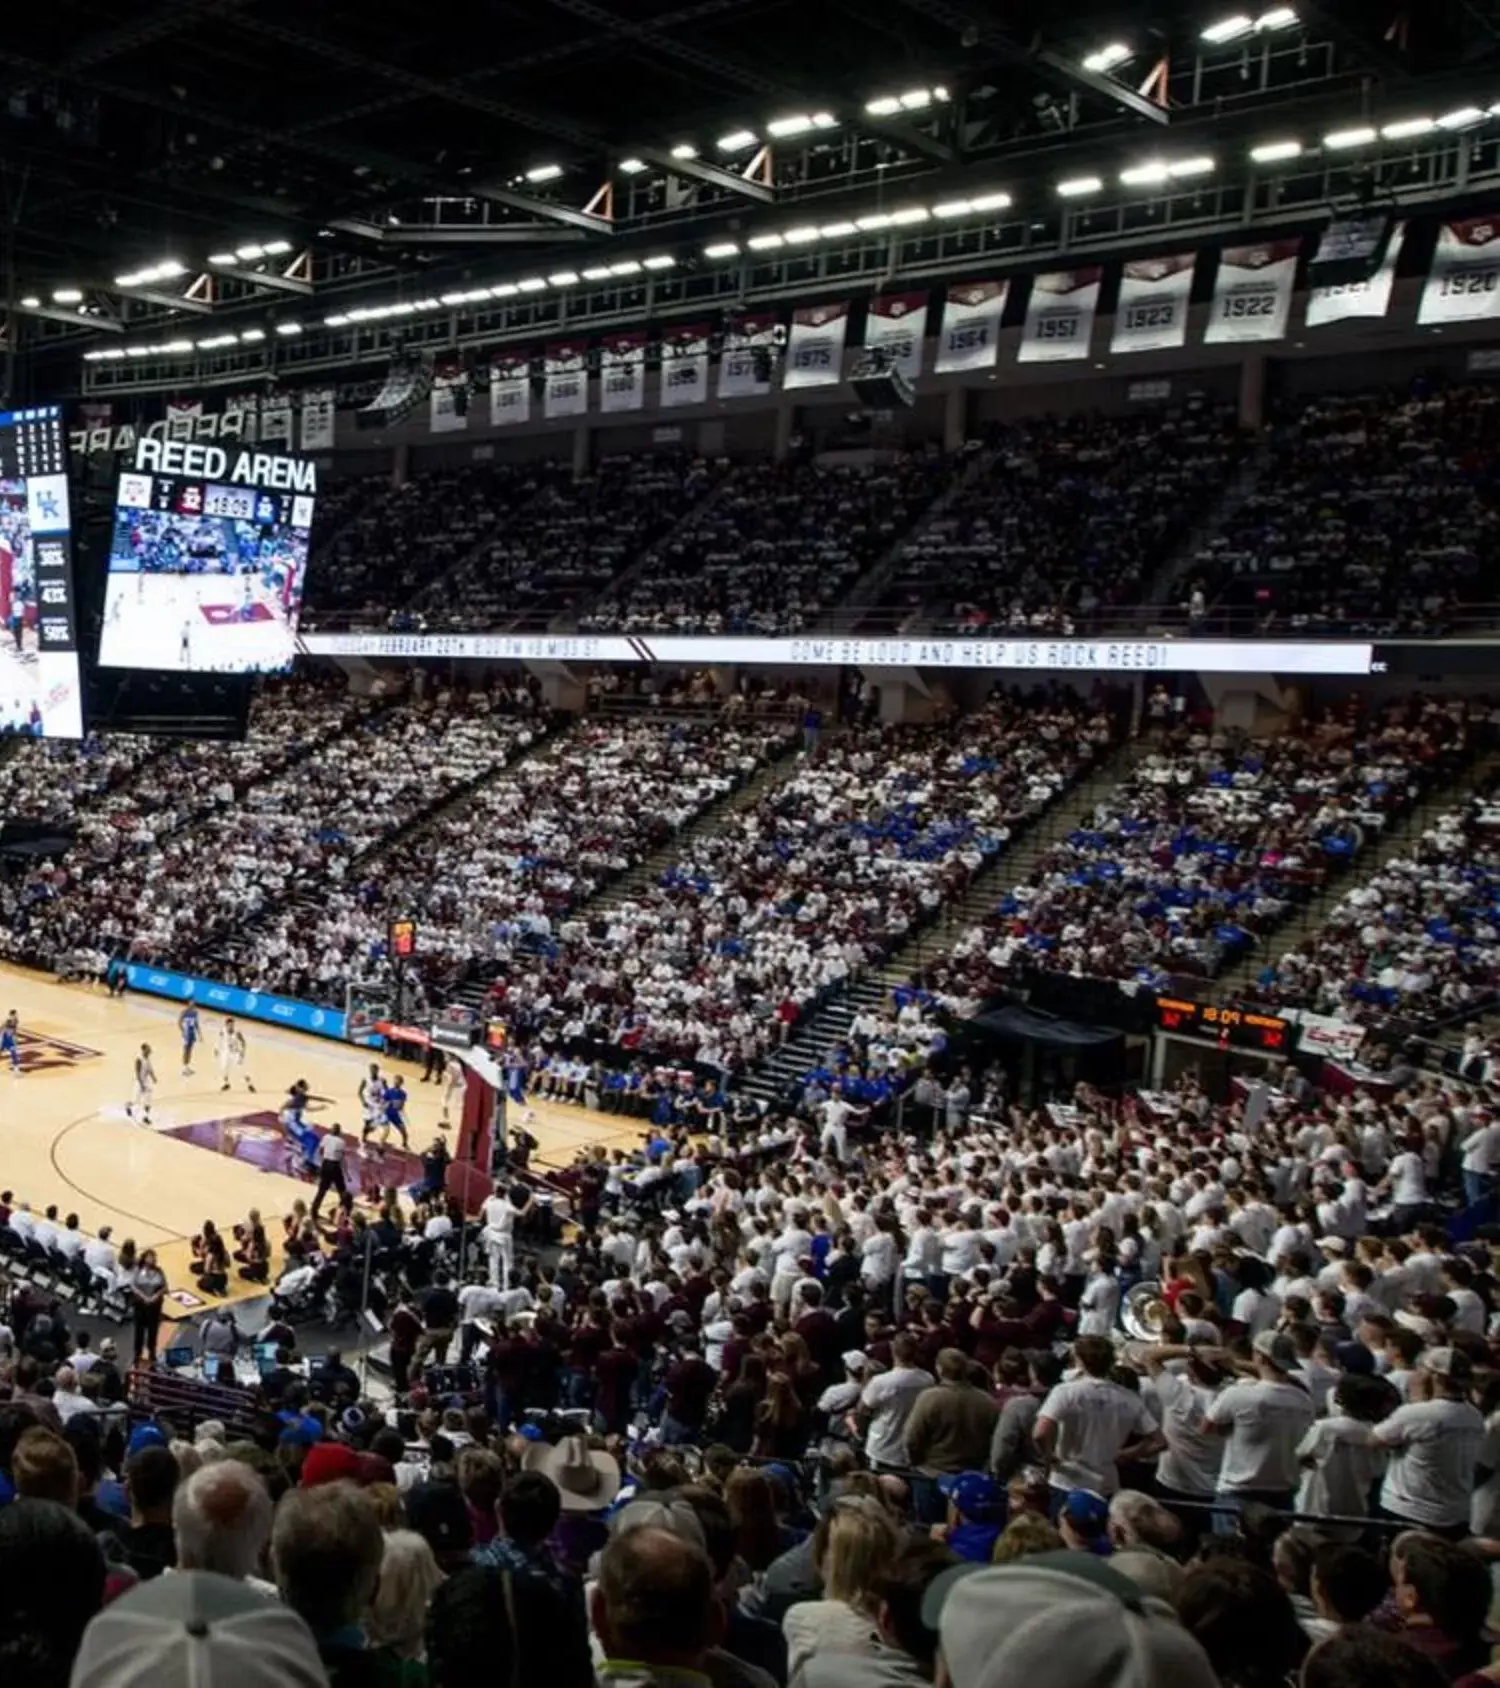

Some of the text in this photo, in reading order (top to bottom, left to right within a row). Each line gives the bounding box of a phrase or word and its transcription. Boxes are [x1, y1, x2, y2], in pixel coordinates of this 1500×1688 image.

[1221, 296, 1275, 318] 1922
[1035, 319, 1077, 339] 1951
[1124, 307, 1174, 330] 1923
[135, 437, 318, 493] REED ARENA
[212, 497, 250, 517] 18:09
[380, 638, 432, 654] FEBRUARY
[792, 641, 1168, 668] COME BE LOUD AND HELP US ROCK REED!
[1203, 1006, 1241, 1026] 18:09
